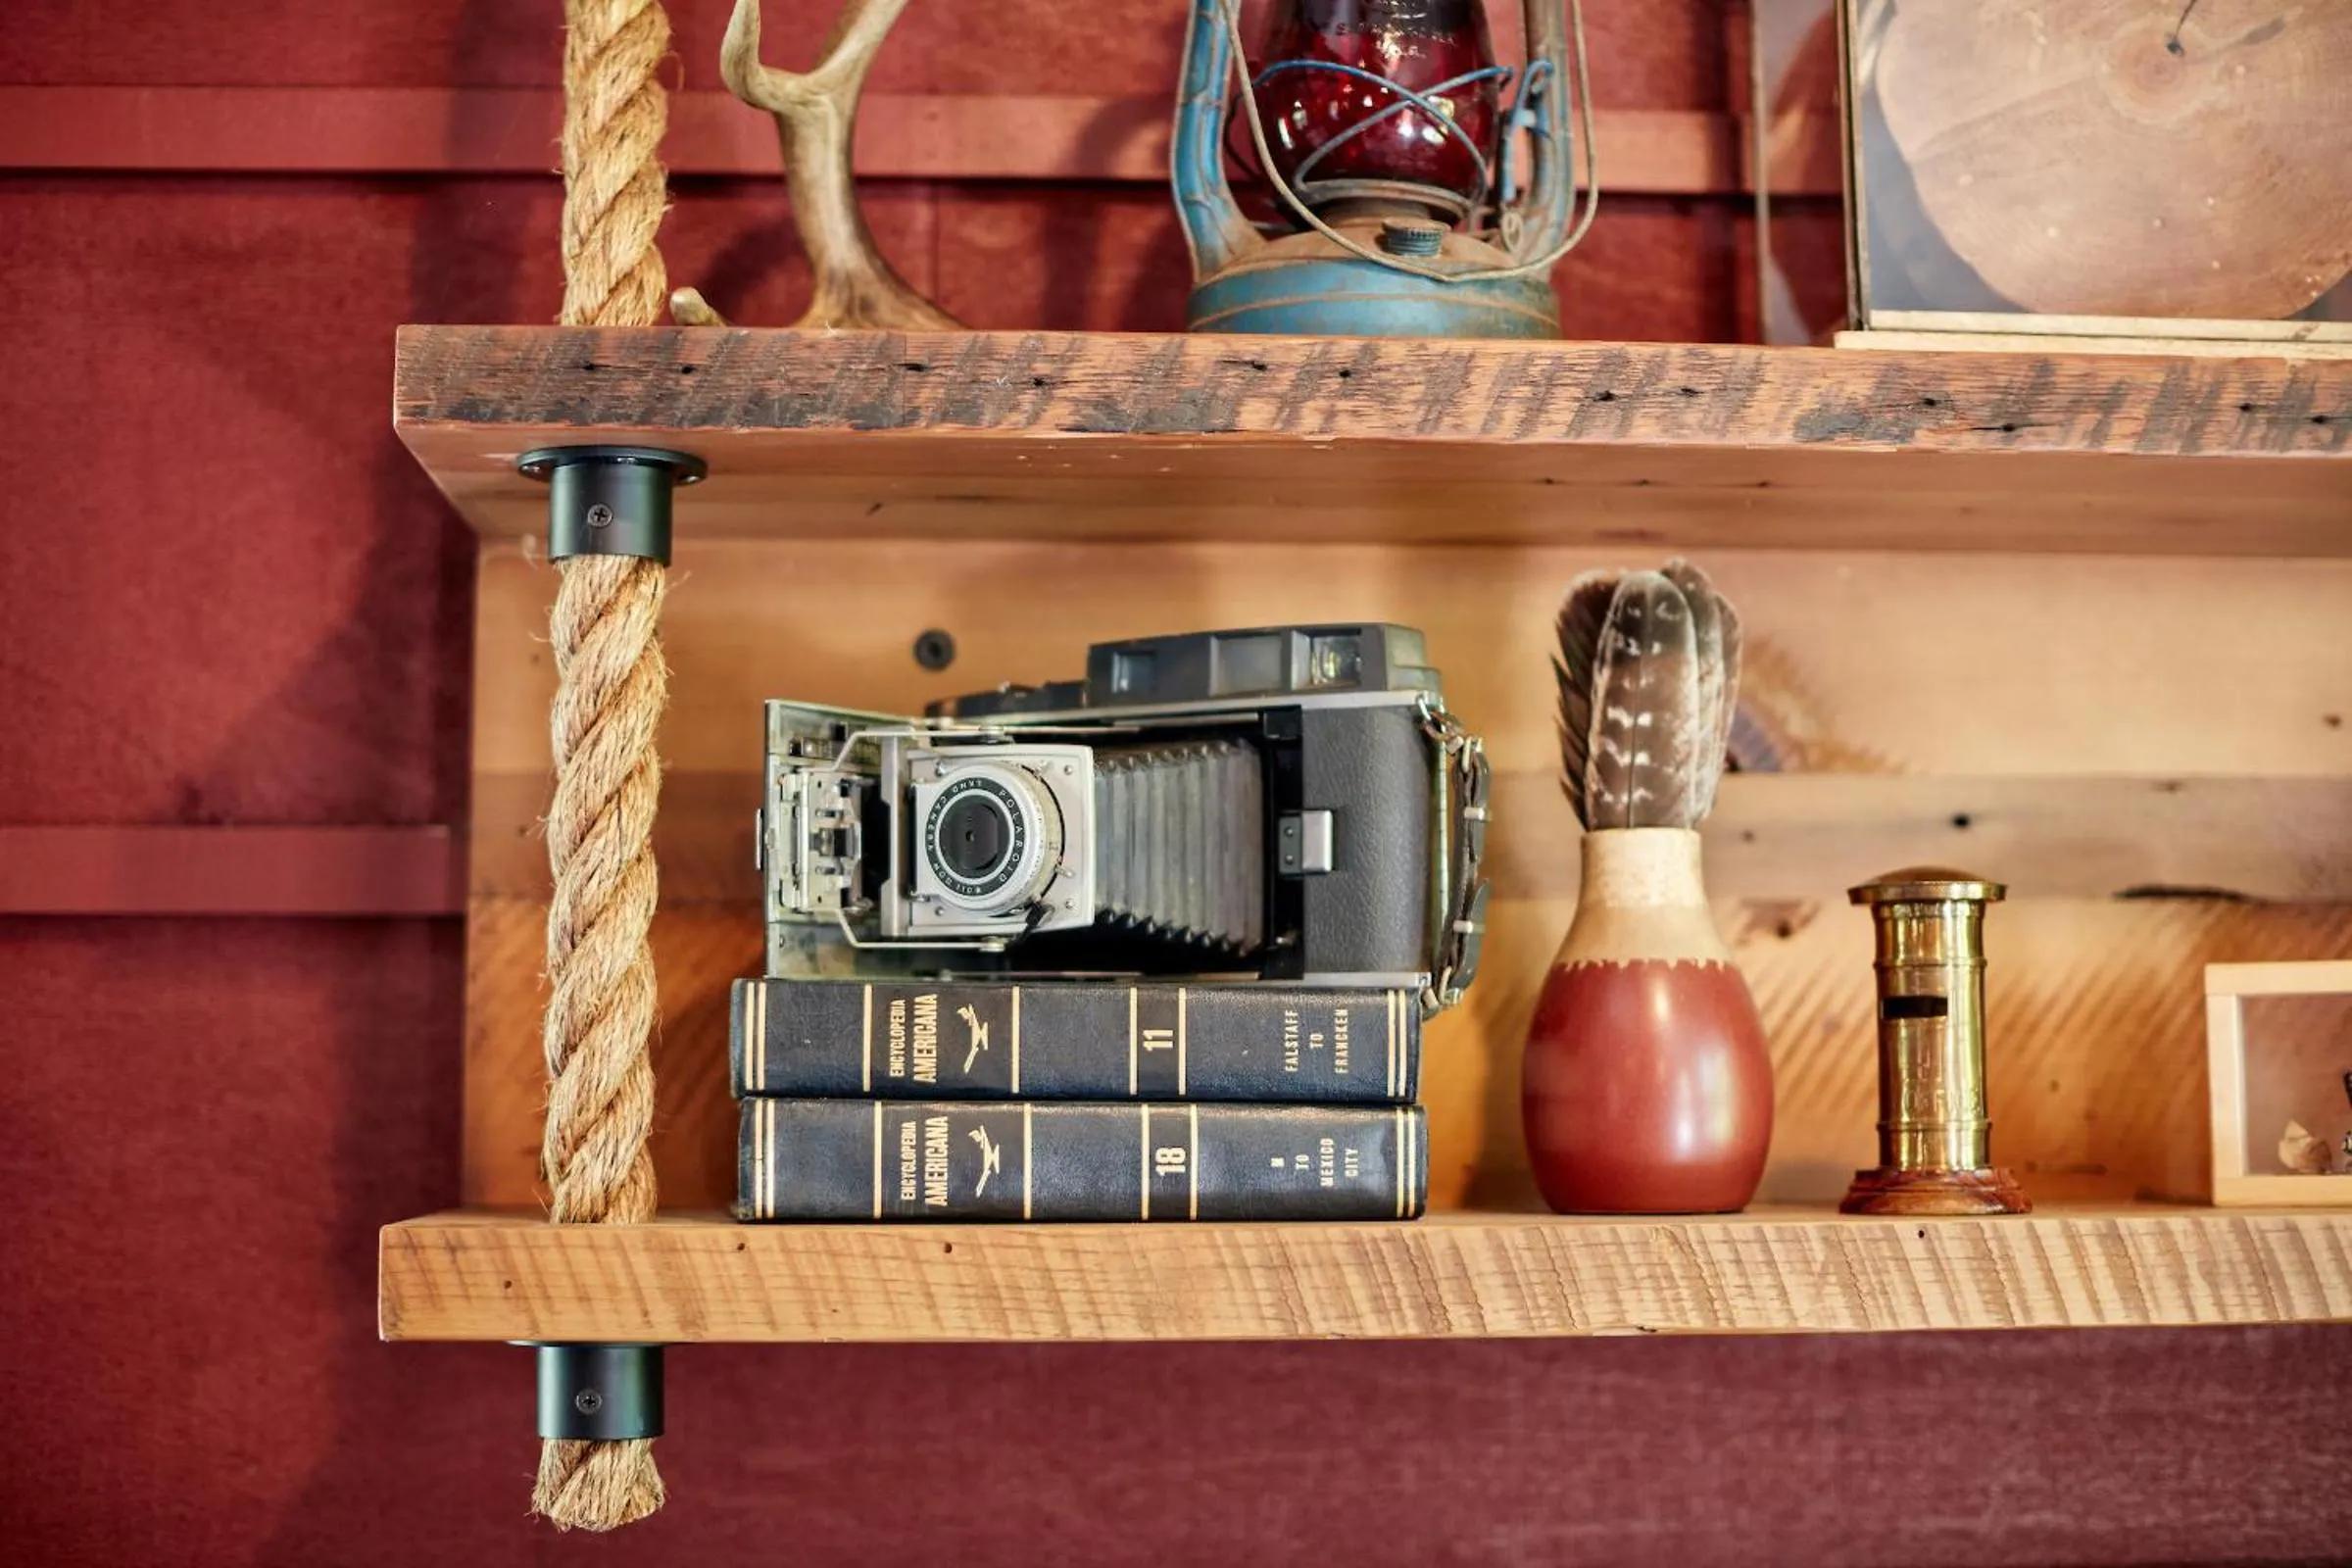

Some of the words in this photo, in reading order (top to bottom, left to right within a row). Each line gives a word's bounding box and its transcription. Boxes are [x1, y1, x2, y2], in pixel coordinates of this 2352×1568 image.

[953, 780, 983, 793] LAND
[927, 796, 948, 851] CAMERA
[998, 788, 1023, 883] POLAROID
[890, 999, 906, 1077] ENCYCLOPEDIA
[913, 994, 937, 1083] AMERICANA
[1143, 1029, 1174, 1052] 11
[1285, 1009, 1298, 1072] FALSTAFF
[1309, 1033, 1323, 1050] TO
[1335, 1008, 1348, 1074] FRANCKEN
[901, 1120, 916, 1200] ENCYCLOPEDIA
[924, 1115, 949, 1206] AMERICANA
[1155, 1147, 1186, 1176] 18
[1296, 1154, 1309, 1169] TO
[1320, 1138, 1334, 1187] MEXICO
[1345, 1148, 1358, 1177] CITY
